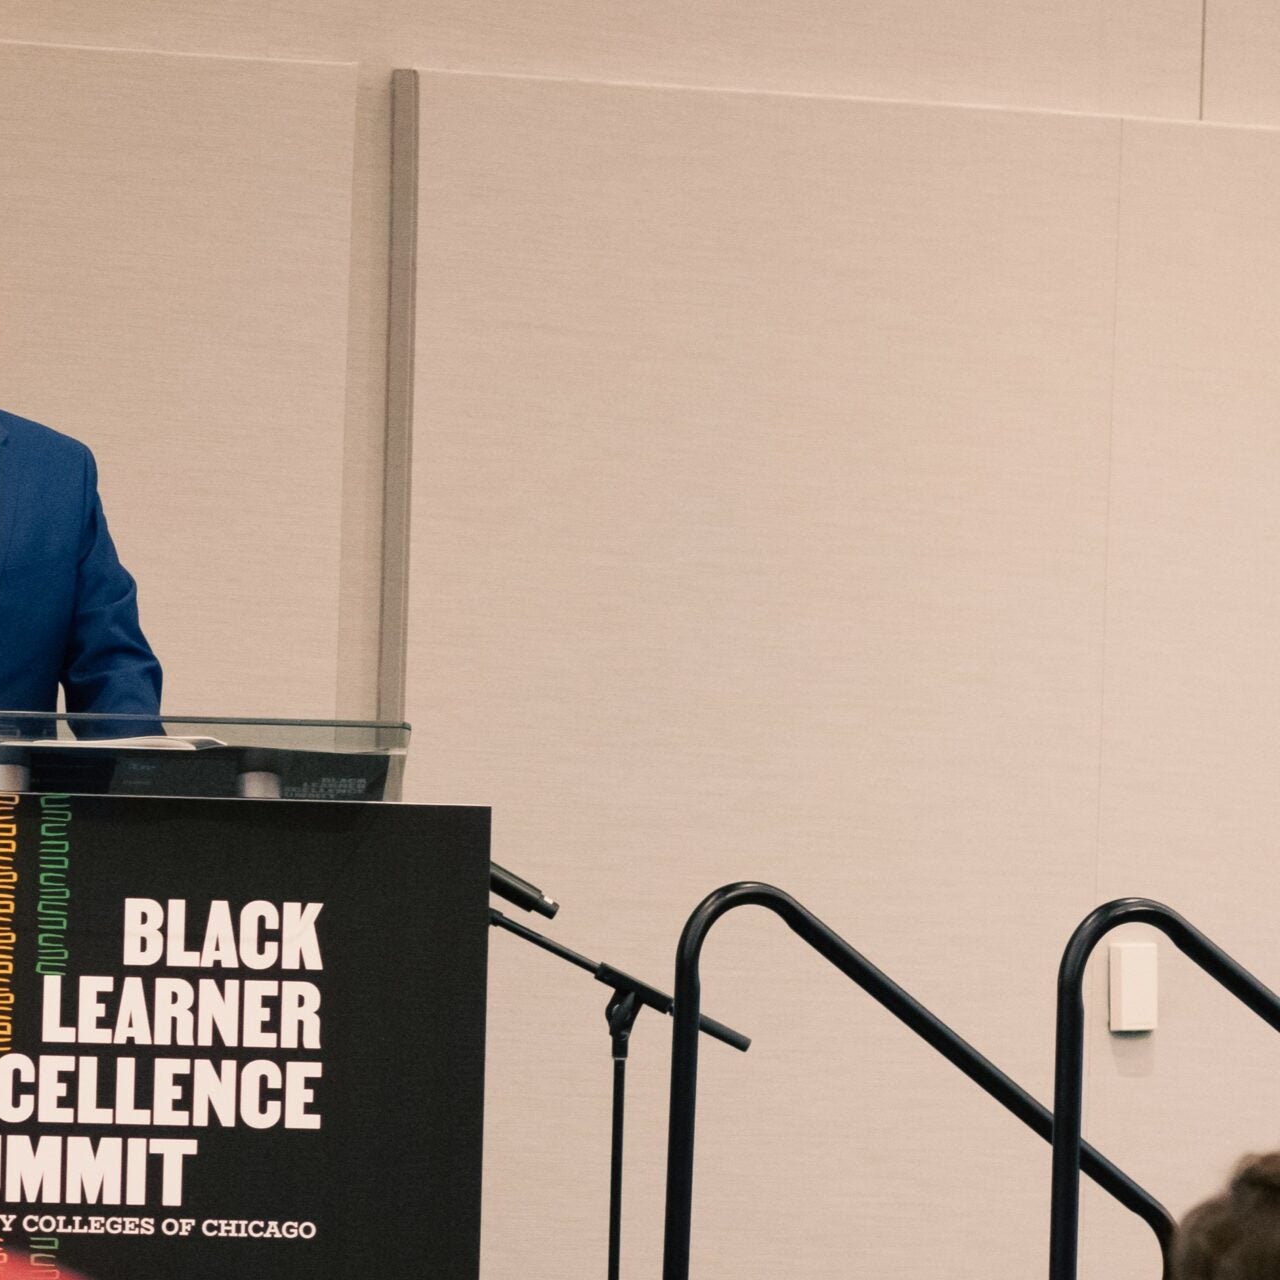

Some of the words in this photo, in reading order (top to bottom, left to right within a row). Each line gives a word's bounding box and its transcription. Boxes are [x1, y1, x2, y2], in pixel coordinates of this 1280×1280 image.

[123, 897, 324, 971] BLACK
[41, 974, 322, 1050] LEARNER
[22, 1214, 155, 1235] COLLEGES
[161, 1218, 196, 1236] OF
[201, 1219, 317, 1239] CHICAGO
